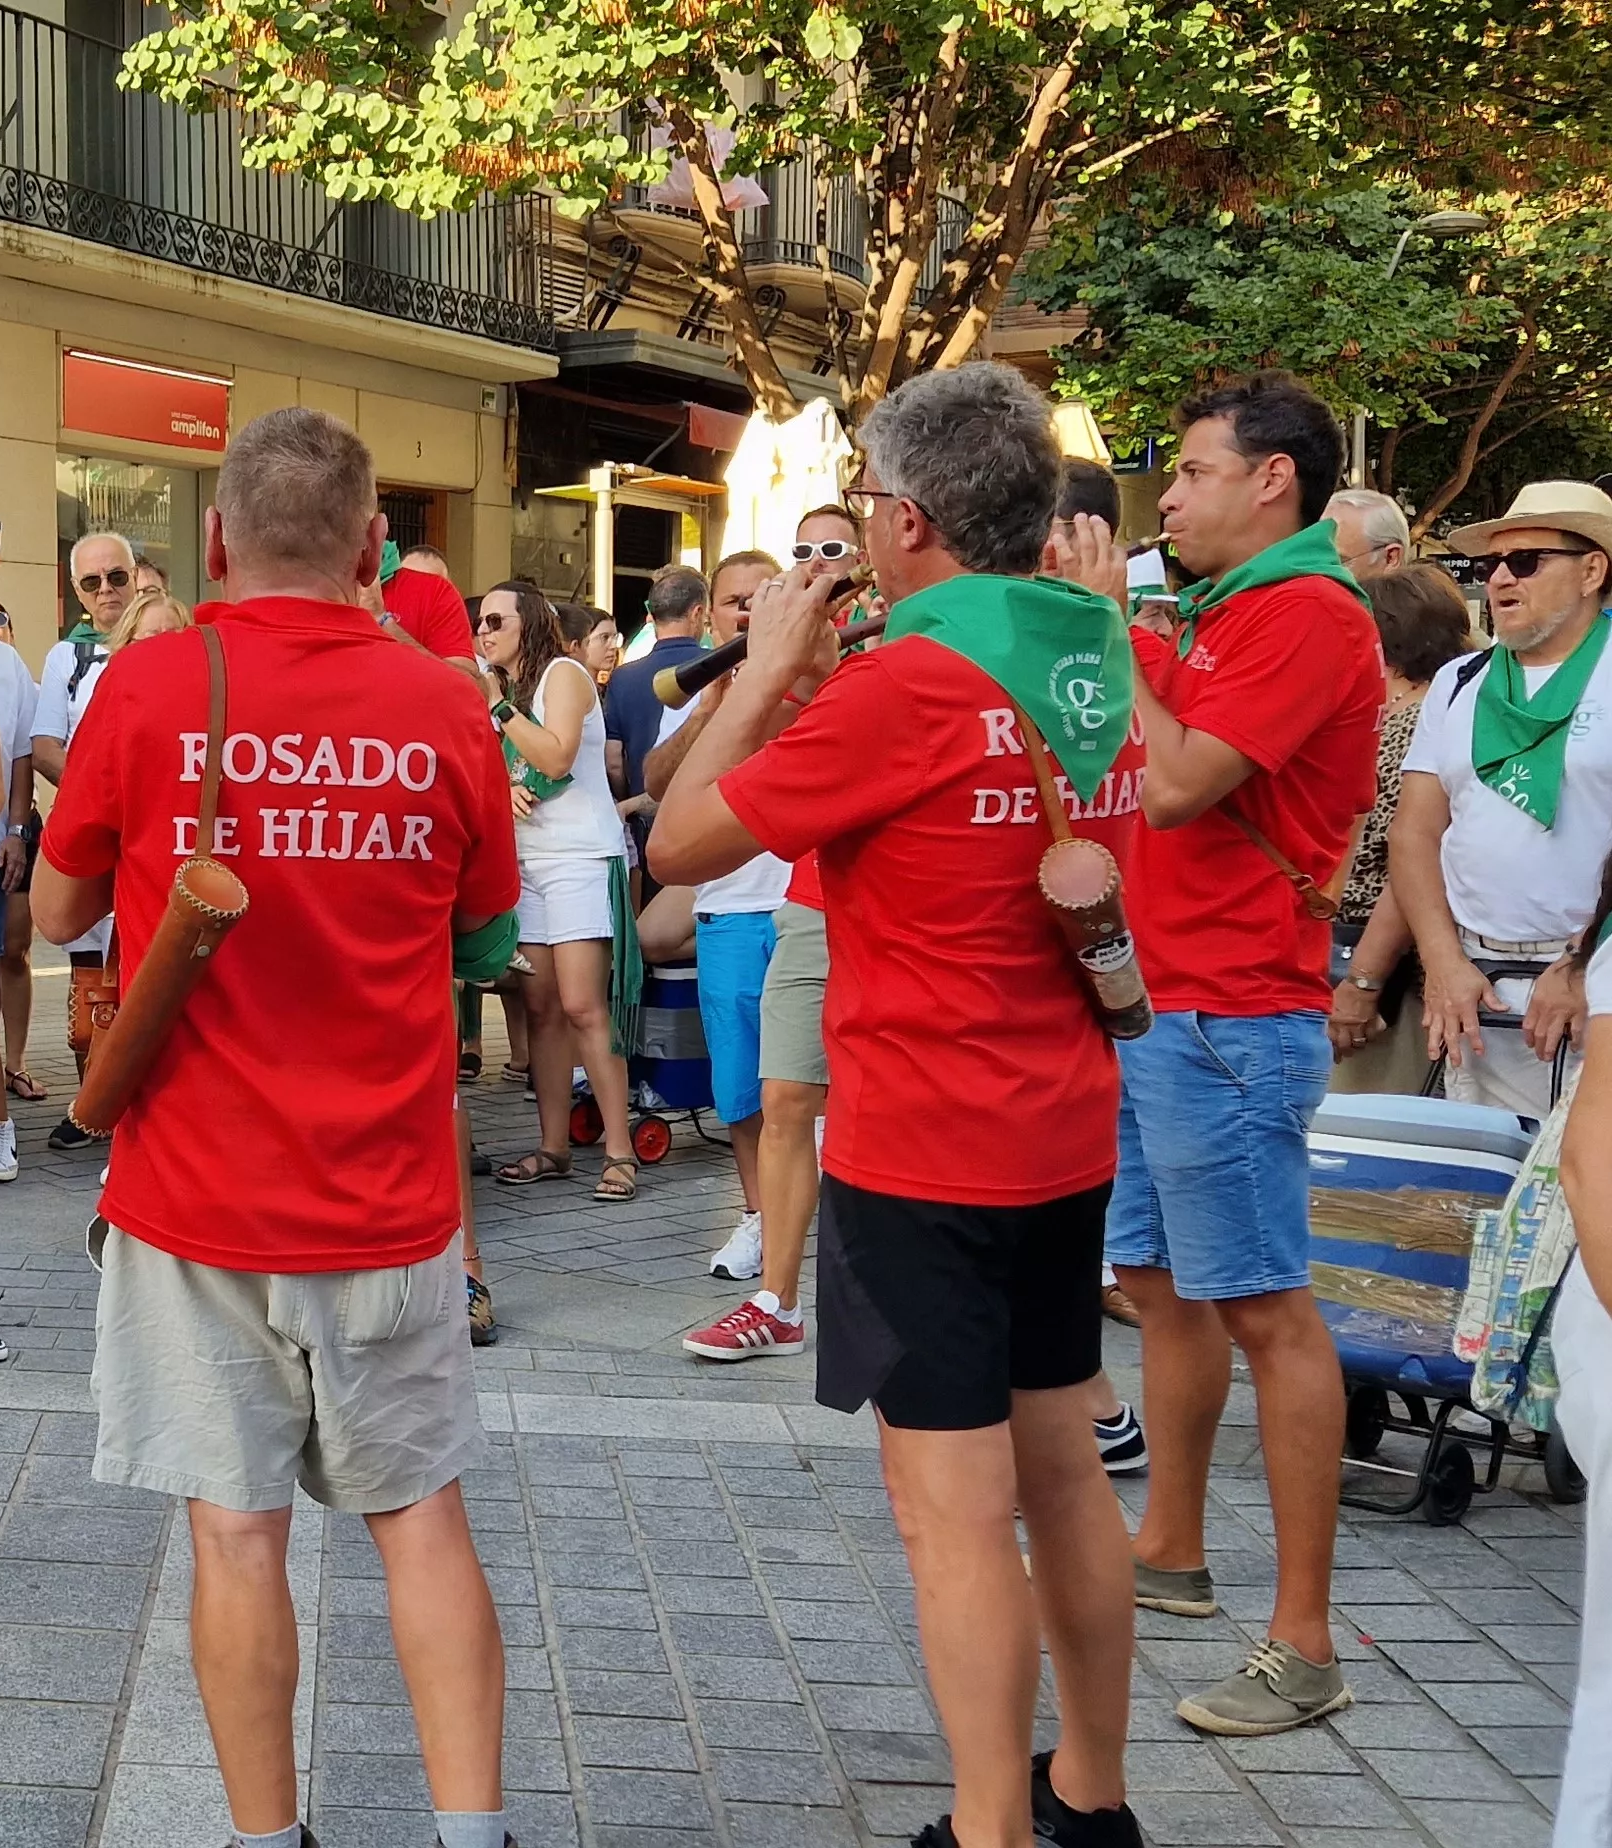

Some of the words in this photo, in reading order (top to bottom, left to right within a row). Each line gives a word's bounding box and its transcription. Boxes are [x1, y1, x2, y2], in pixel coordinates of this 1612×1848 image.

[171, 419, 220, 439] amplifon
[416, 441, 422, 458] 3
[178, 732, 437, 792] ROSADO
[970, 787, 1038, 824] DE
[172, 816, 241, 856] DE
[258, 797, 433, 861] HÍJAR
